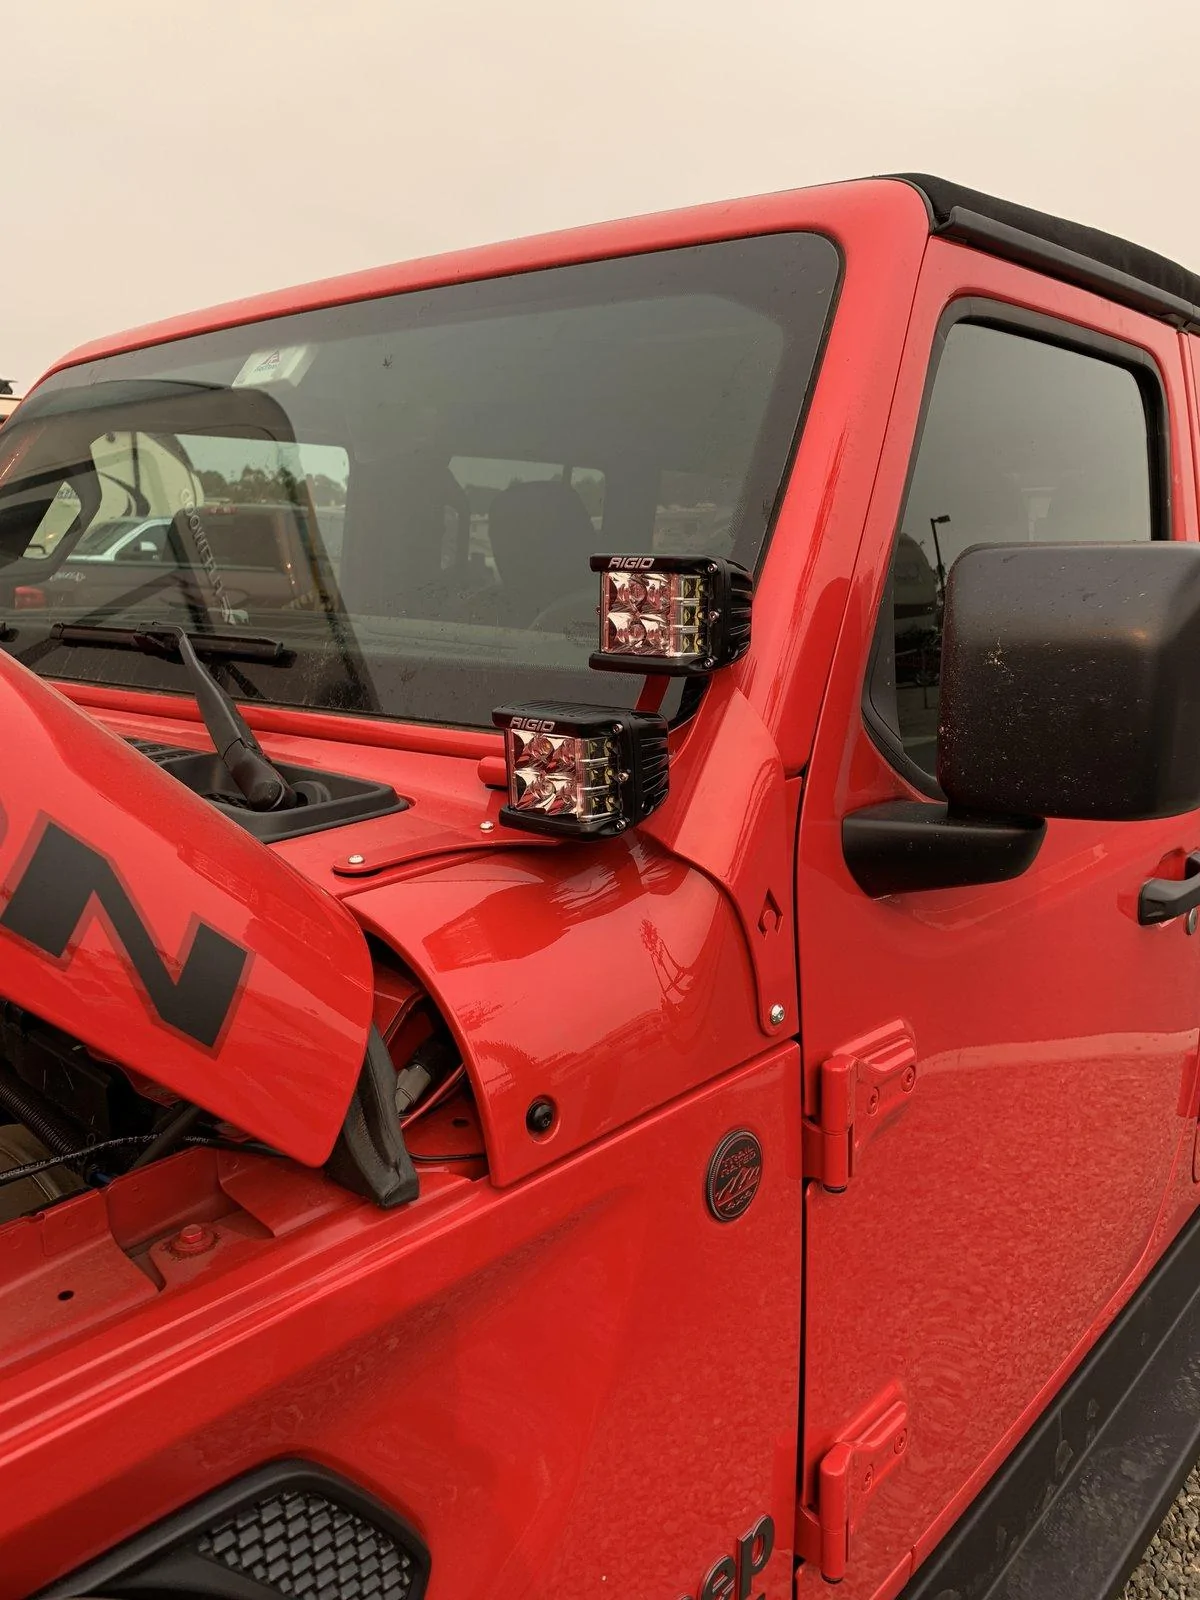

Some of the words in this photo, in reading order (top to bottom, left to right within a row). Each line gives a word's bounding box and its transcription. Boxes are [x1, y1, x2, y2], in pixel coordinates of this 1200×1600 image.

[608, 557, 655, 569] RIGID
[509, 716, 556, 732] RIGID
[0, 809, 256, 1060] N
[678, 1513, 775, 1600] ep
